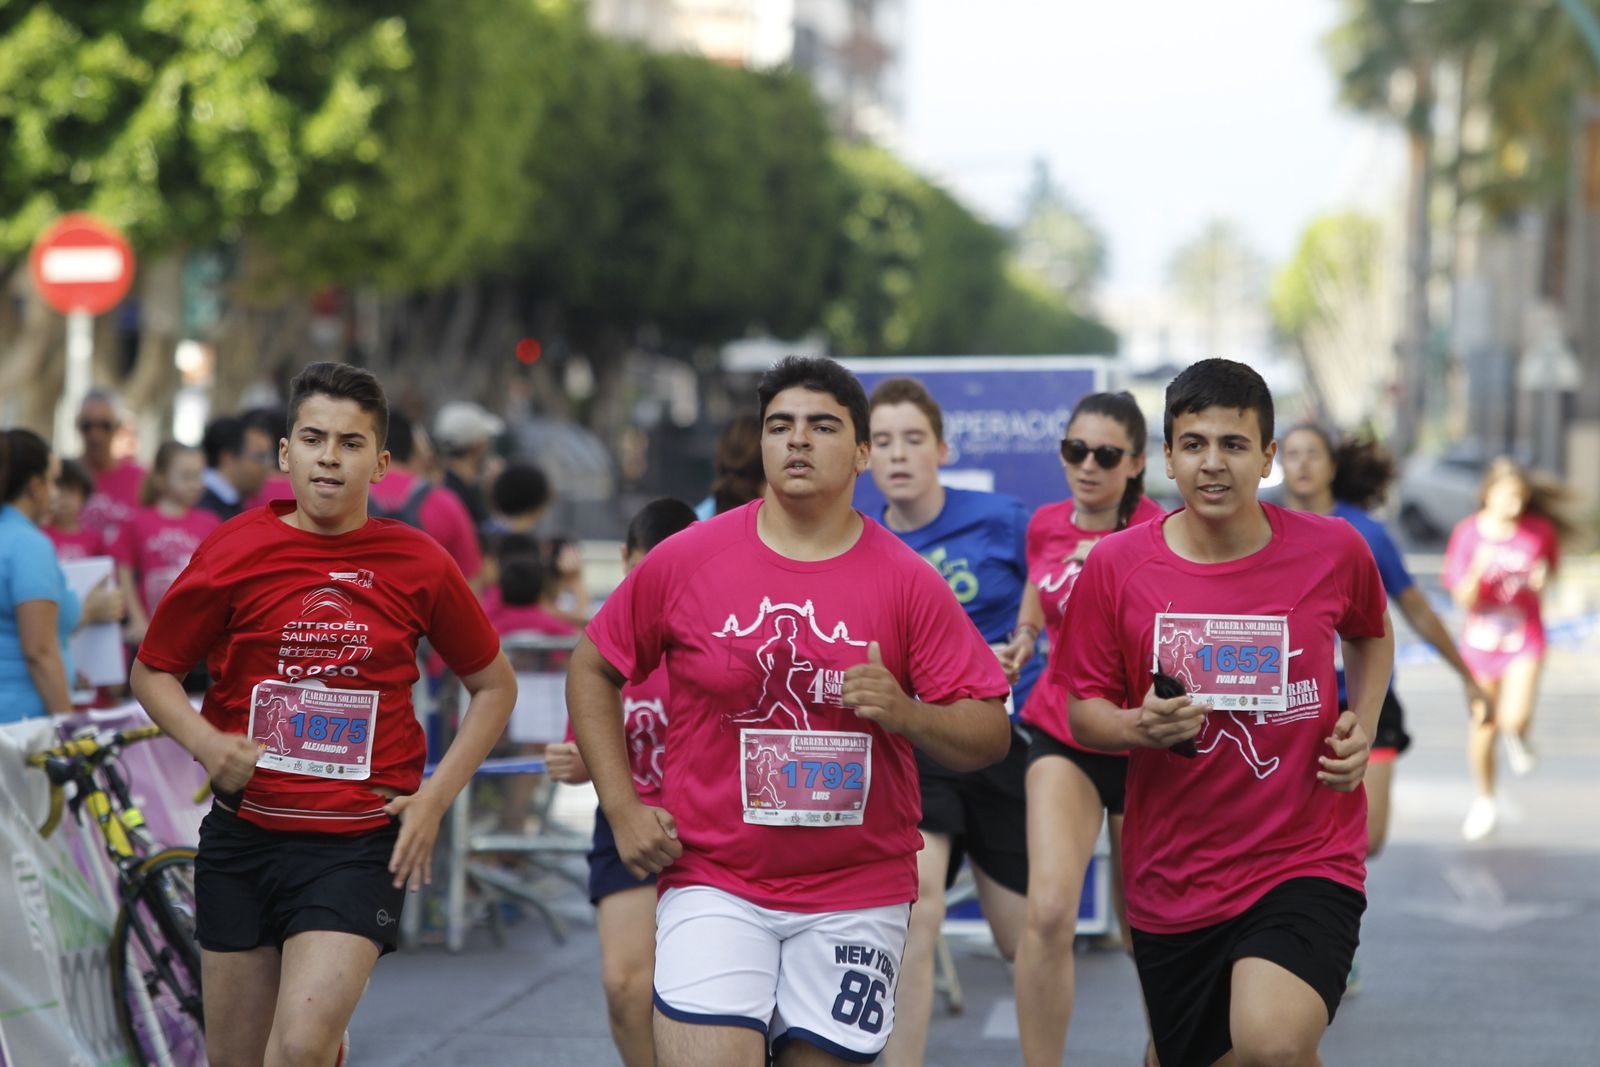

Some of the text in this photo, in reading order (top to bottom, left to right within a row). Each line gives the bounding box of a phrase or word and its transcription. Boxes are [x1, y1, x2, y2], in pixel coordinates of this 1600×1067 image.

[1211, 621, 1244, 630] CARRERA
[1245, 622, 1282, 631] SOLIDARIA
[281, 631, 367, 644] SALINAS CAR
[1196, 644, 1280, 673] 1652
[807, 668, 825, 704] 4
[1216, 674, 1257, 685] IVAN SAN
[305, 691, 337, 703] CARRERA
[338, 695, 371, 705] SOLIDARIA
[289, 712, 368, 744] 1875
[301, 741, 348, 754] ALEJANDRO
[795, 737, 828, 747] CARRERA
[829, 737, 865, 748] SOLIDARIA
[781, 760, 864, 790] 1792
[811, 791, 831, 801] LUIS
[835, 945, 895, 988] NEW YORK
[831, 970, 887, 1034] 86
